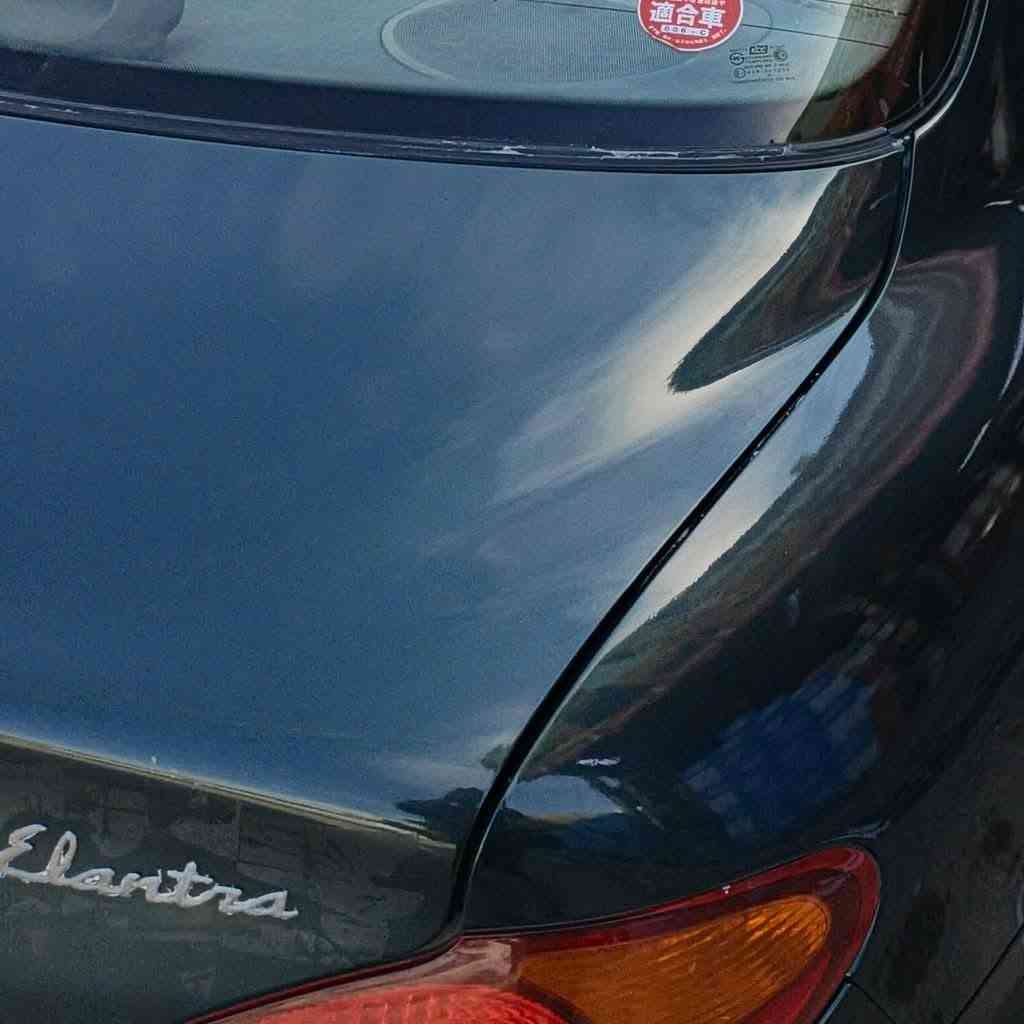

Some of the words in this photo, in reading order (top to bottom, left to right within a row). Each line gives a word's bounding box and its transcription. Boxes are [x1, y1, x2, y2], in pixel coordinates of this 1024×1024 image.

[648, 1, 726, 29] 適合車
[0, 824, 299, 920] Elantra
